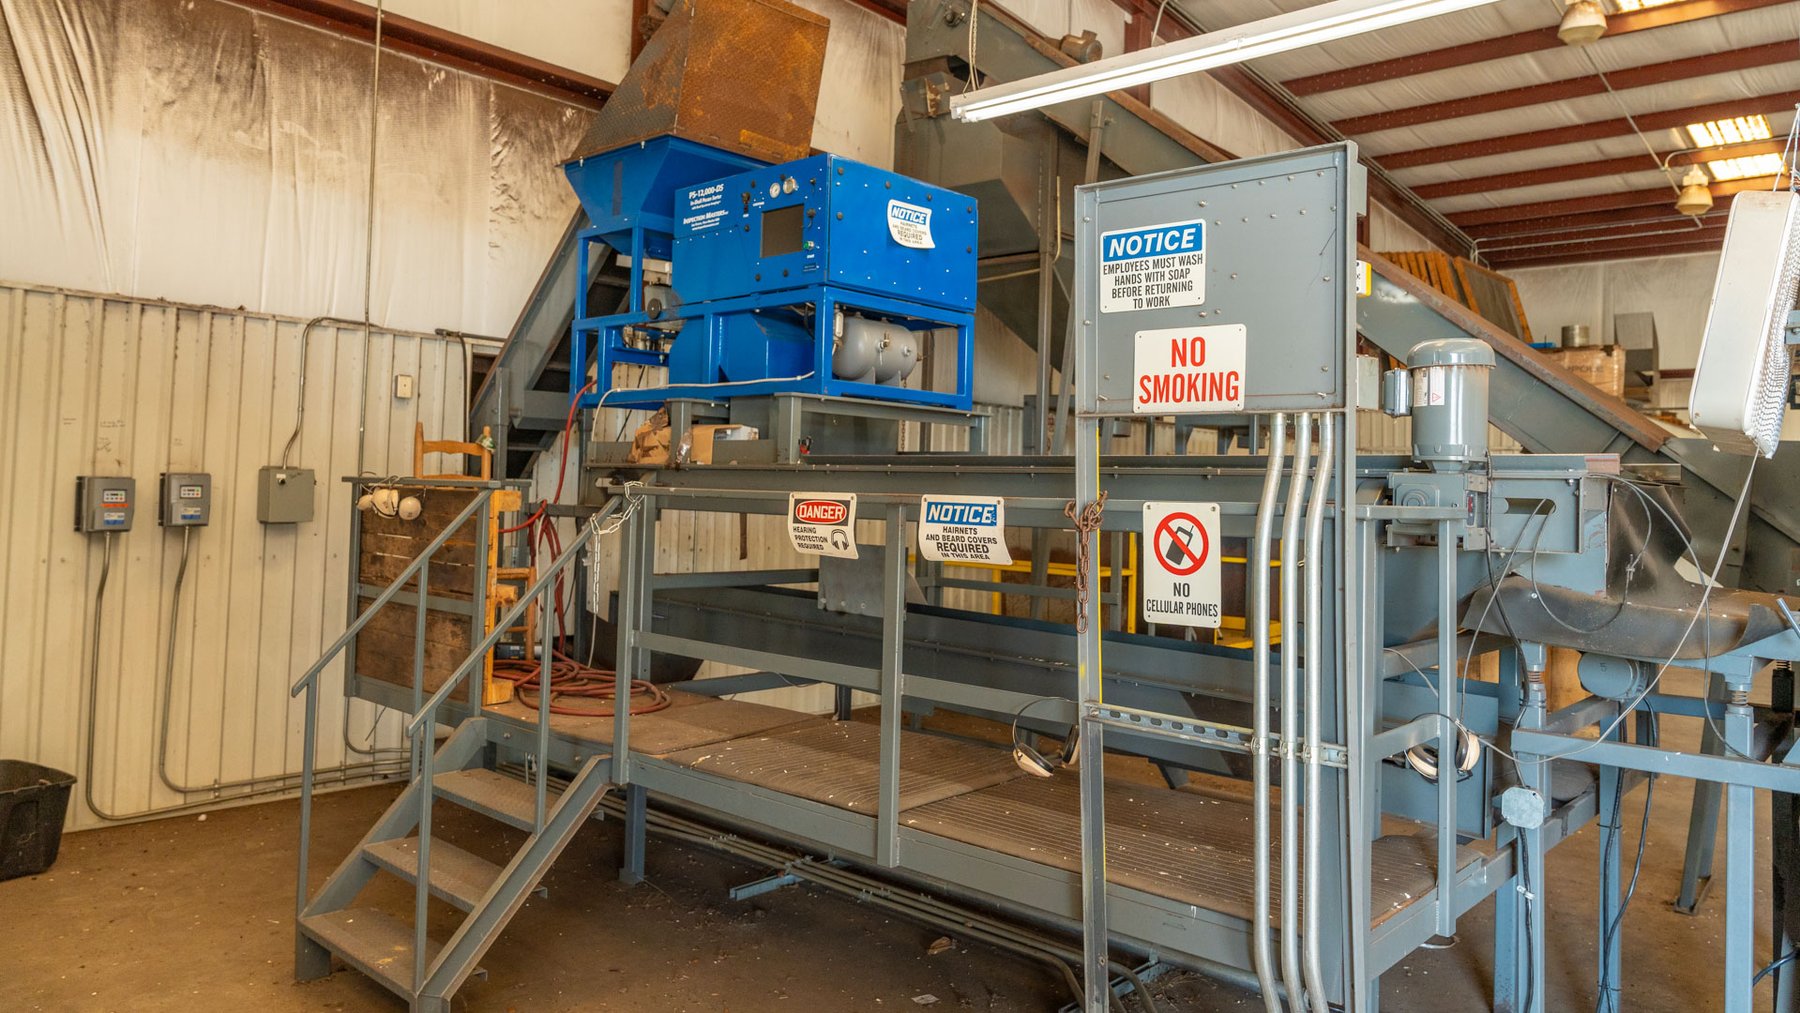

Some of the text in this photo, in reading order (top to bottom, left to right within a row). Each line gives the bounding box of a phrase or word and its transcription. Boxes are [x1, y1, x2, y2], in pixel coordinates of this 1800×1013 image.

[892, 206, 926, 224] NOTICE
[1108, 228, 1196, 258] NOTICE
[1104, 254, 1203, 275] EMPLOYEES MUST WASH
[1114, 268, 1190, 286] HANDS WITH SOAP
[1112, 280, 1193, 299] BEFORE RETURNING
[1133, 296, 1170, 309] TO WORK
[1171, 336, 1206, 368] NO
[1138, 370, 1239, 404] SMOKING
[799, 505, 844, 520] DANGER
[928, 504, 994, 524] NOTICE
[793, 526, 816, 534] HEARING
[794, 534, 828, 543] PROTECTION
[942, 526, 978, 535] HAIRNETS
[797, 542, 824, 550] REQUIRED
[936, 542, 989, 553] REQUIRED
[968, 536, 998, 544] COVERS
[1174, 582, 1190, 598] NO
[1146, 599, 1218, 617] CELLULAR PHONES
